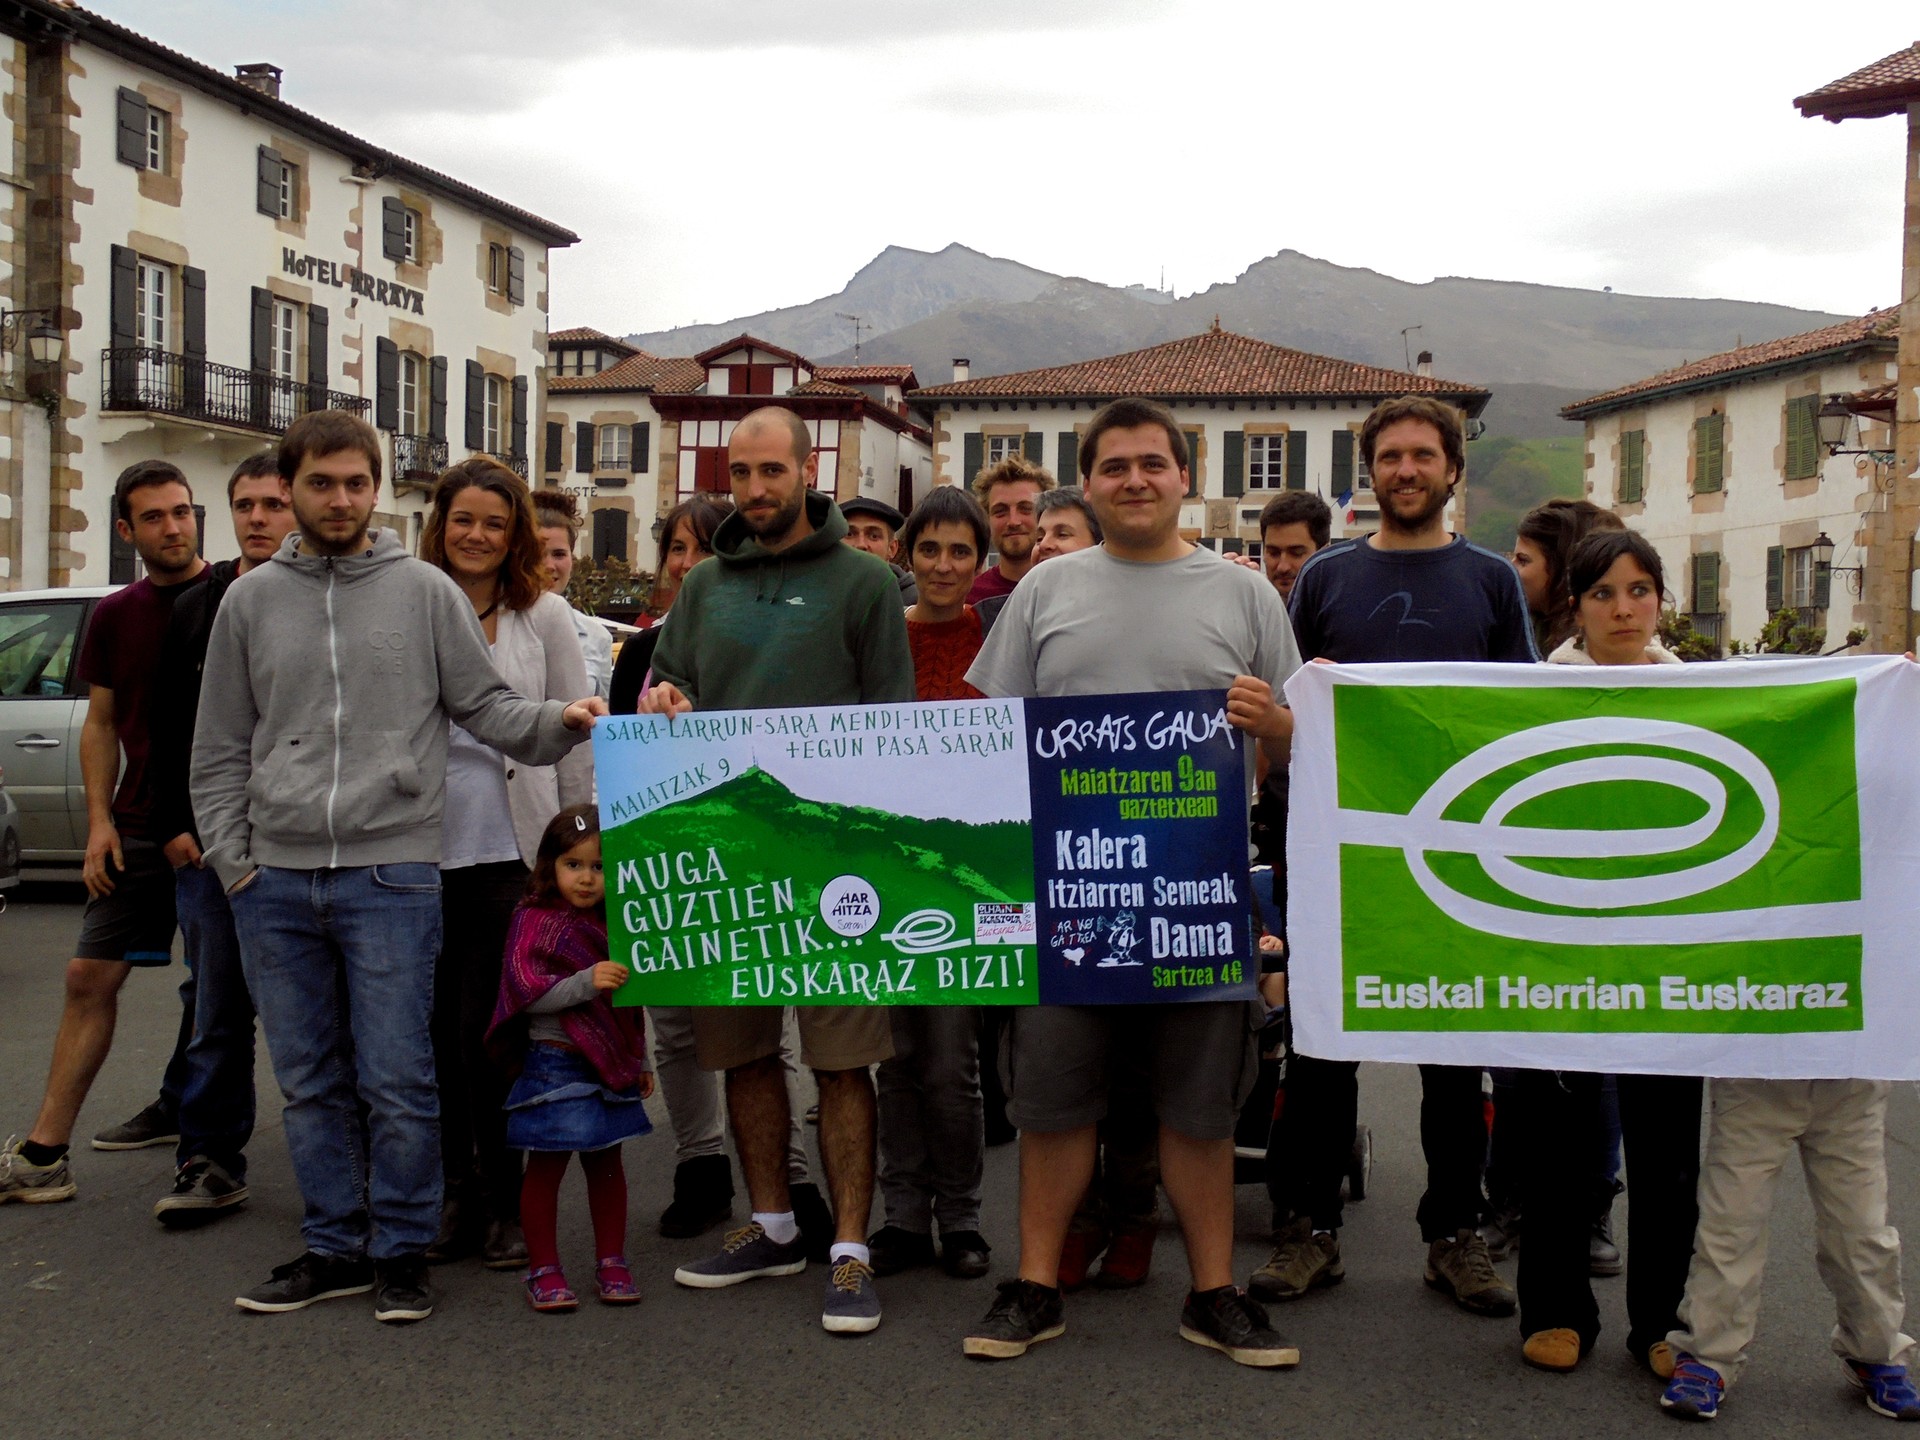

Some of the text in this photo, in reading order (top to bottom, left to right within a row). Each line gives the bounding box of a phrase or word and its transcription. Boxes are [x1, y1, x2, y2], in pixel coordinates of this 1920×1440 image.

[283, 246, 425, 316] HOTEL ARRAYA
[606, 704, 1014, 744] SARA-LARRUN-SARA MENDI-IRTEERA
[877, 735, 929, 756] PASA
[941, 731, 1014, 758] SARAN
[1035, 708, 1236, 759] URRATS GAUA
[610, 757, 731, 822] MAIATZAK 9
[1061, 754, 1217, 796] Maiatzaren 9an
[1120, 796, 1218, 820] gaztetxean
[1055, 828, 1149, 871] Kalera
[616, 847, 728, 895] MUGA
[1048, 872, 1238, 909] Itziarren Semeak
[623, 877, 794, 934] GUZTIEN
[831, 904, 873, 916] HITZA
[840, 892, 869, 904] HAR
[631, 915, 864, 974] GAINETIK...
[1150, 916, 1234, 959] Dama
[731, 948, 1025, 1001] EUSKARAZ BIZI!
[1152, 959, 1243, 988] Sartzea 4€
[1355, 975, 1849, 1010] Euskal Herrian Euskaraz
